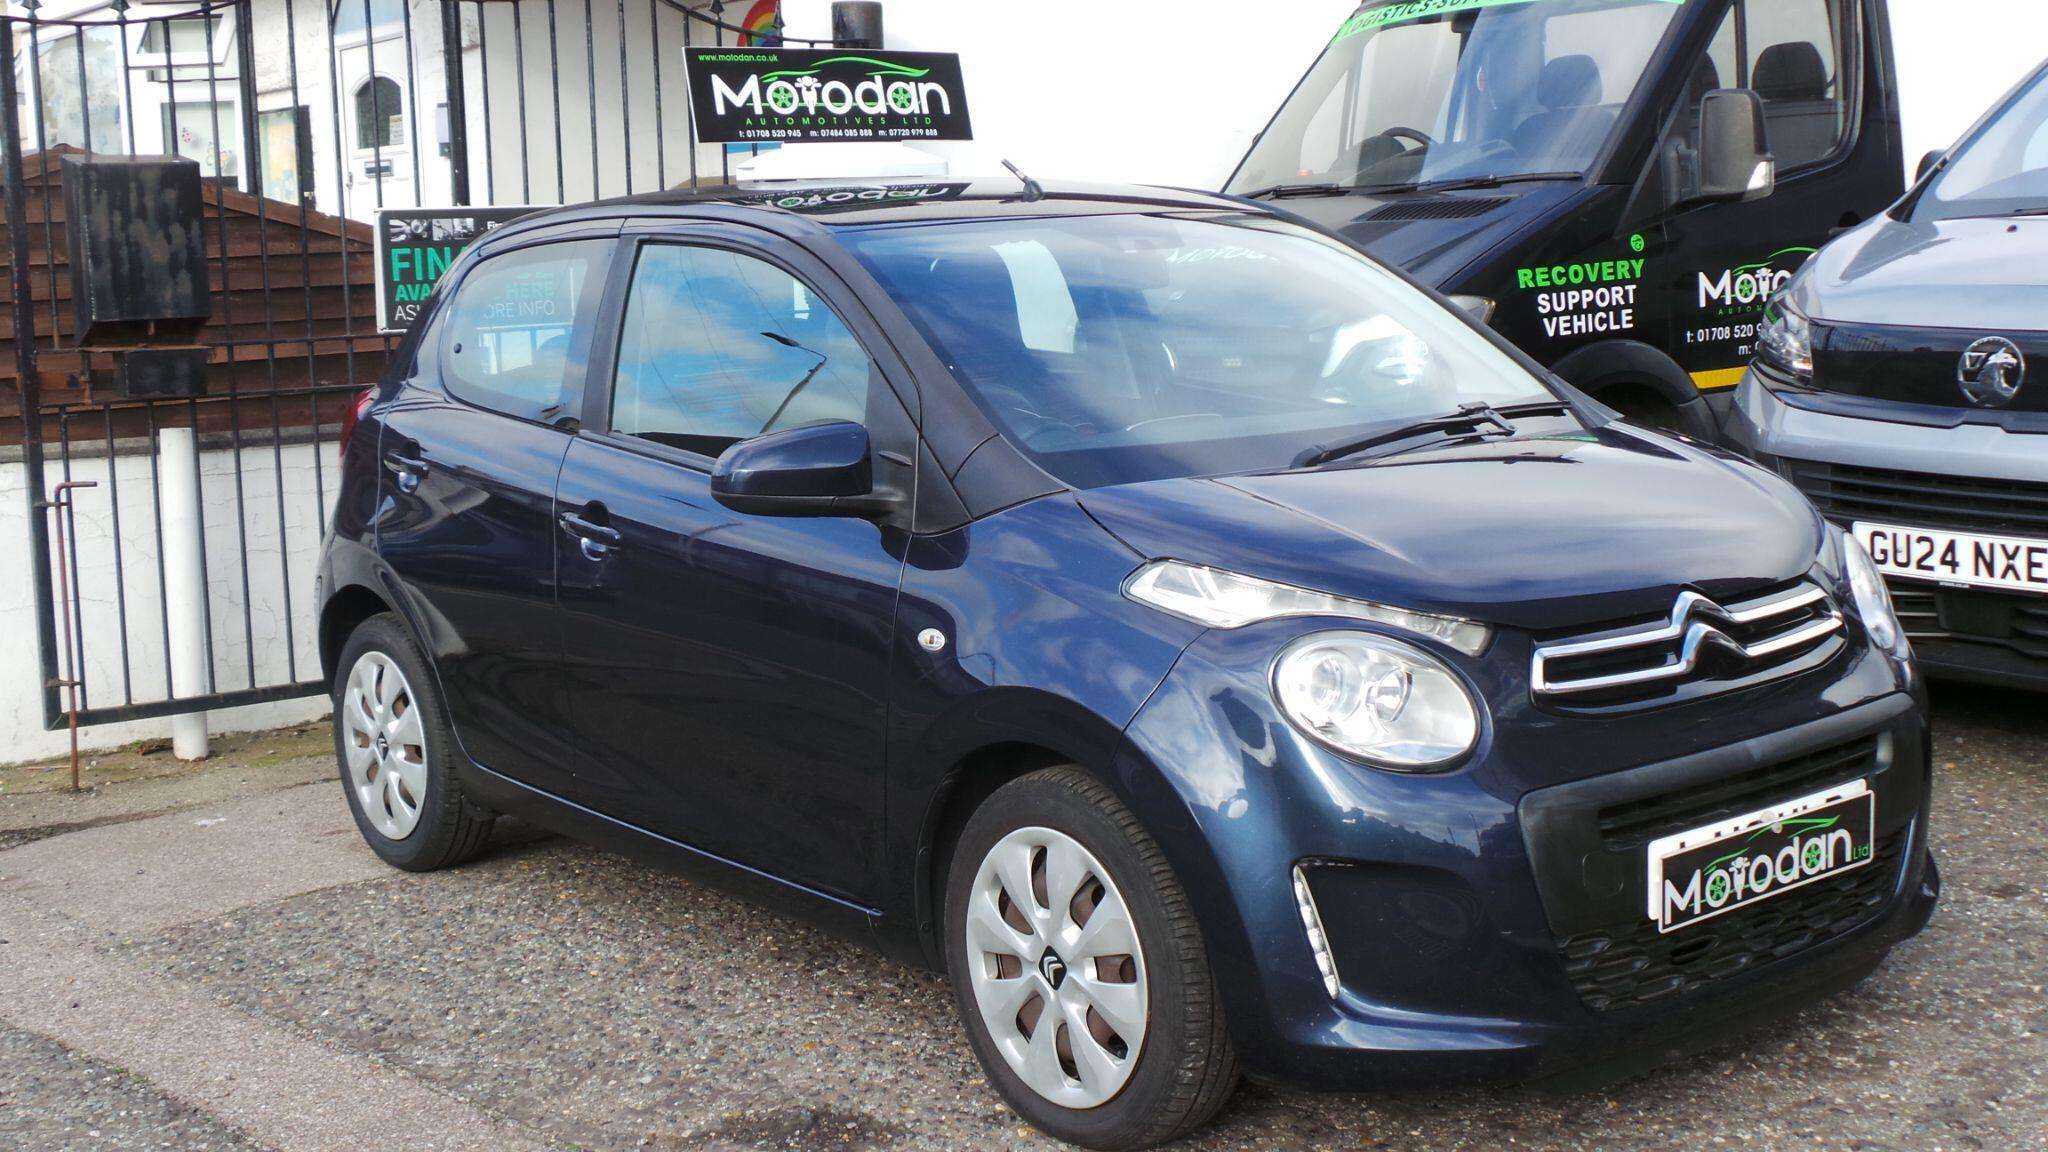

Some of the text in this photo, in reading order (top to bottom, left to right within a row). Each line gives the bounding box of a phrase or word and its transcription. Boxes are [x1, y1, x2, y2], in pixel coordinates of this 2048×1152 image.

[698, 53, 779, 62] www.motodan.co.uk
[710, 73, 951, 115] Motodan
[745, 116, 932, 126] AUTOMOTIVES LTD
[746, 129, 770, 138] 01708
[771, 129, 786, 138] 520
[878, 129, 888, 137] m:
[391, 246, 467, 282] FIN
[1518, 259, 1644, 288] RECOVERY
[395, 283, 430, 301] AVA
[1537, 284, 1637, 314] SUPPORT
[1698, 267, 1793, 308] Moto
[395, 304, 421, 321] AS
[518, 299, 556, 317] INFO
[1718, 304, 1764, 316] AUTOM
[1542, 308, 1635, 338] VEHICLE
[1686, 331, 1694, 343] t:
[1697, 326, 1731, 343] 01708
[1733, 324, 1753, 339] 520
[1738, 344, 1752, 356] m:
[1870, 530, 2048, 584] GU24 NXE
[1664, 828, 1870, 925] Motodan Ltd
